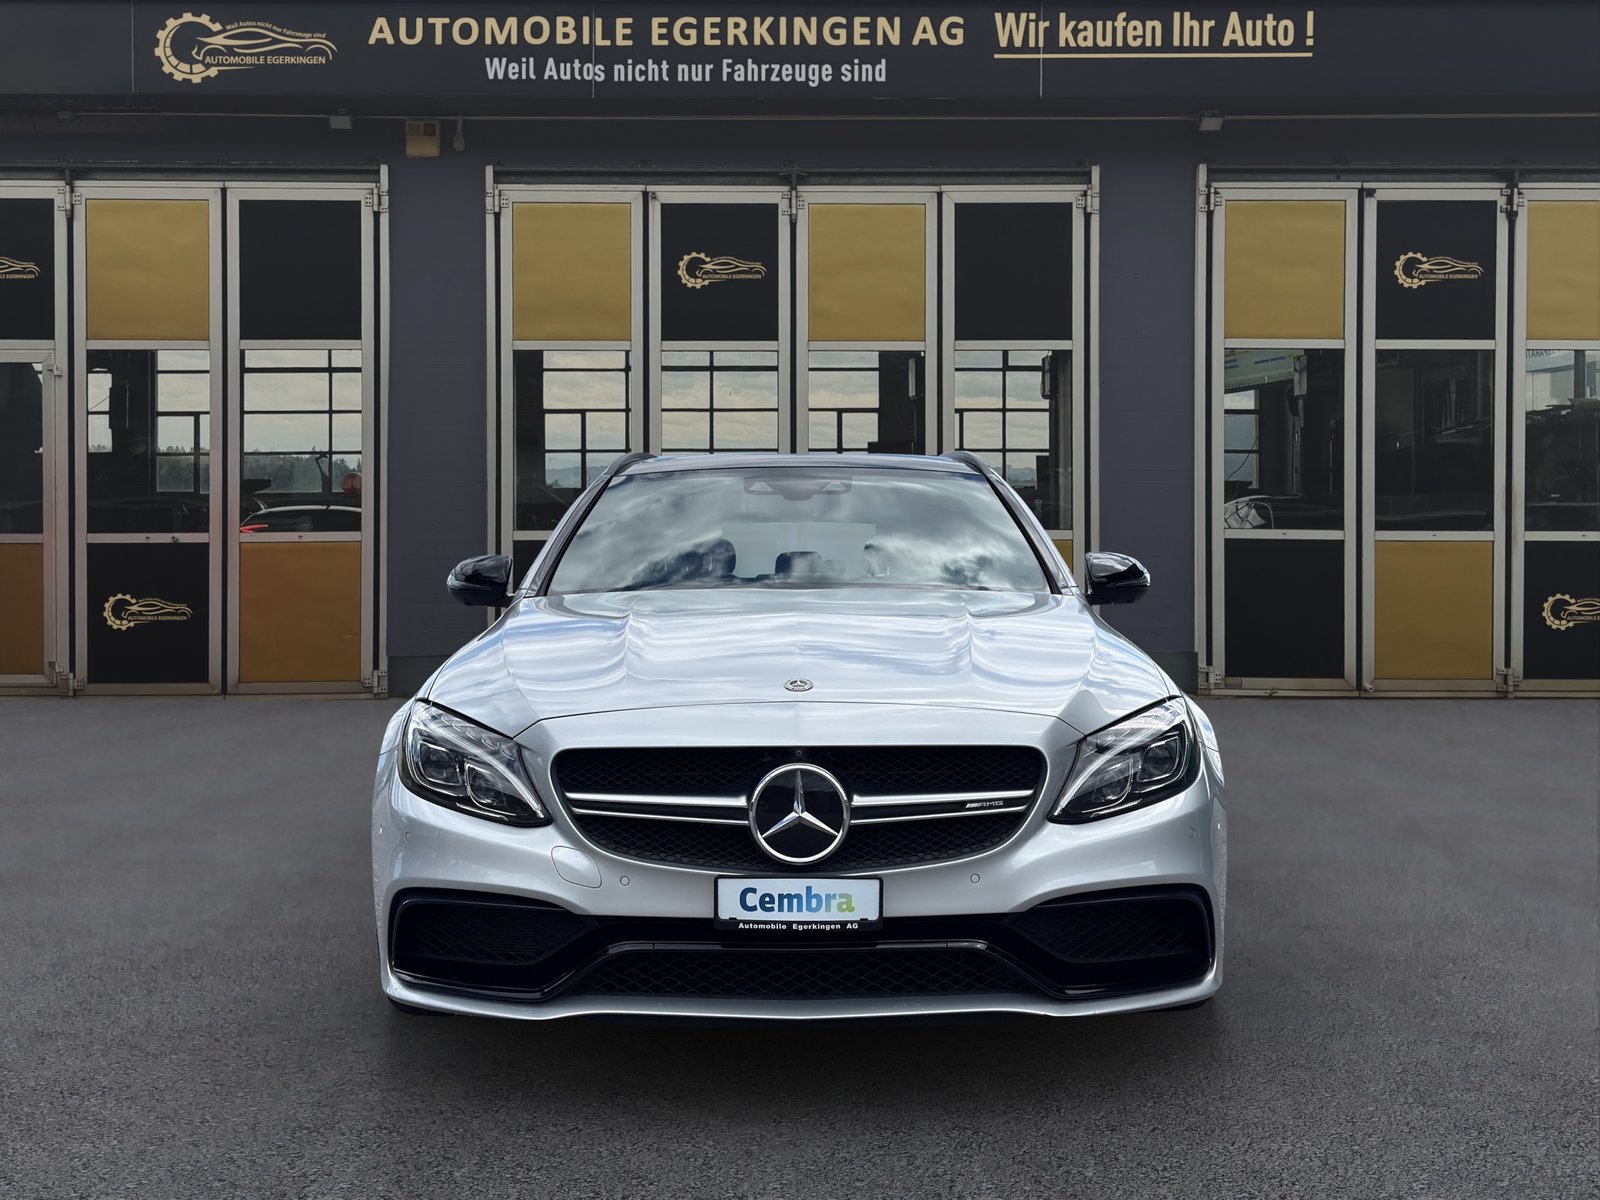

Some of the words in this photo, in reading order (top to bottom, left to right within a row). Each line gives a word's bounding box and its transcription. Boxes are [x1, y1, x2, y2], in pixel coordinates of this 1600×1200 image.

[225, 22, 238, 31] Weil
[257, 21, 273, 30] nicht
[272, 25, 283, 33] nur
[282, 29, 313, 39] Fahrzeuge
[368, 16, 634, 47] AUTOMOBILE
[651, 16, 901, 47] EGERKINGEN
[912, 16, 965, 47] AG
[994, 12, 1050, 48] Wir
[1058, 11, 1162, 48] kaufen
[1173, 11, 1216, 47] Ihr
[1222, 11, 1295, 47] Auto
[204, 55, 265, 65] AUTOMOBILE
[266, 55, 326, 65] EGERKINGEN
[485, 57, 536, 80] Weil
[543, 57, 606, 82] Autos
[613, 58, 670, 82] nicht
[677, 63, 714, 83] nur
[722, 58, 833, 88] Fahrzeuge
[841, 58, 887, 83] sind
[739, 885, 856, 913] Cembra
[738, 922, 787, 930] Automobile
[792, 923, 841, 931] Egerkingen
[846, 922, 859, 930] AG
